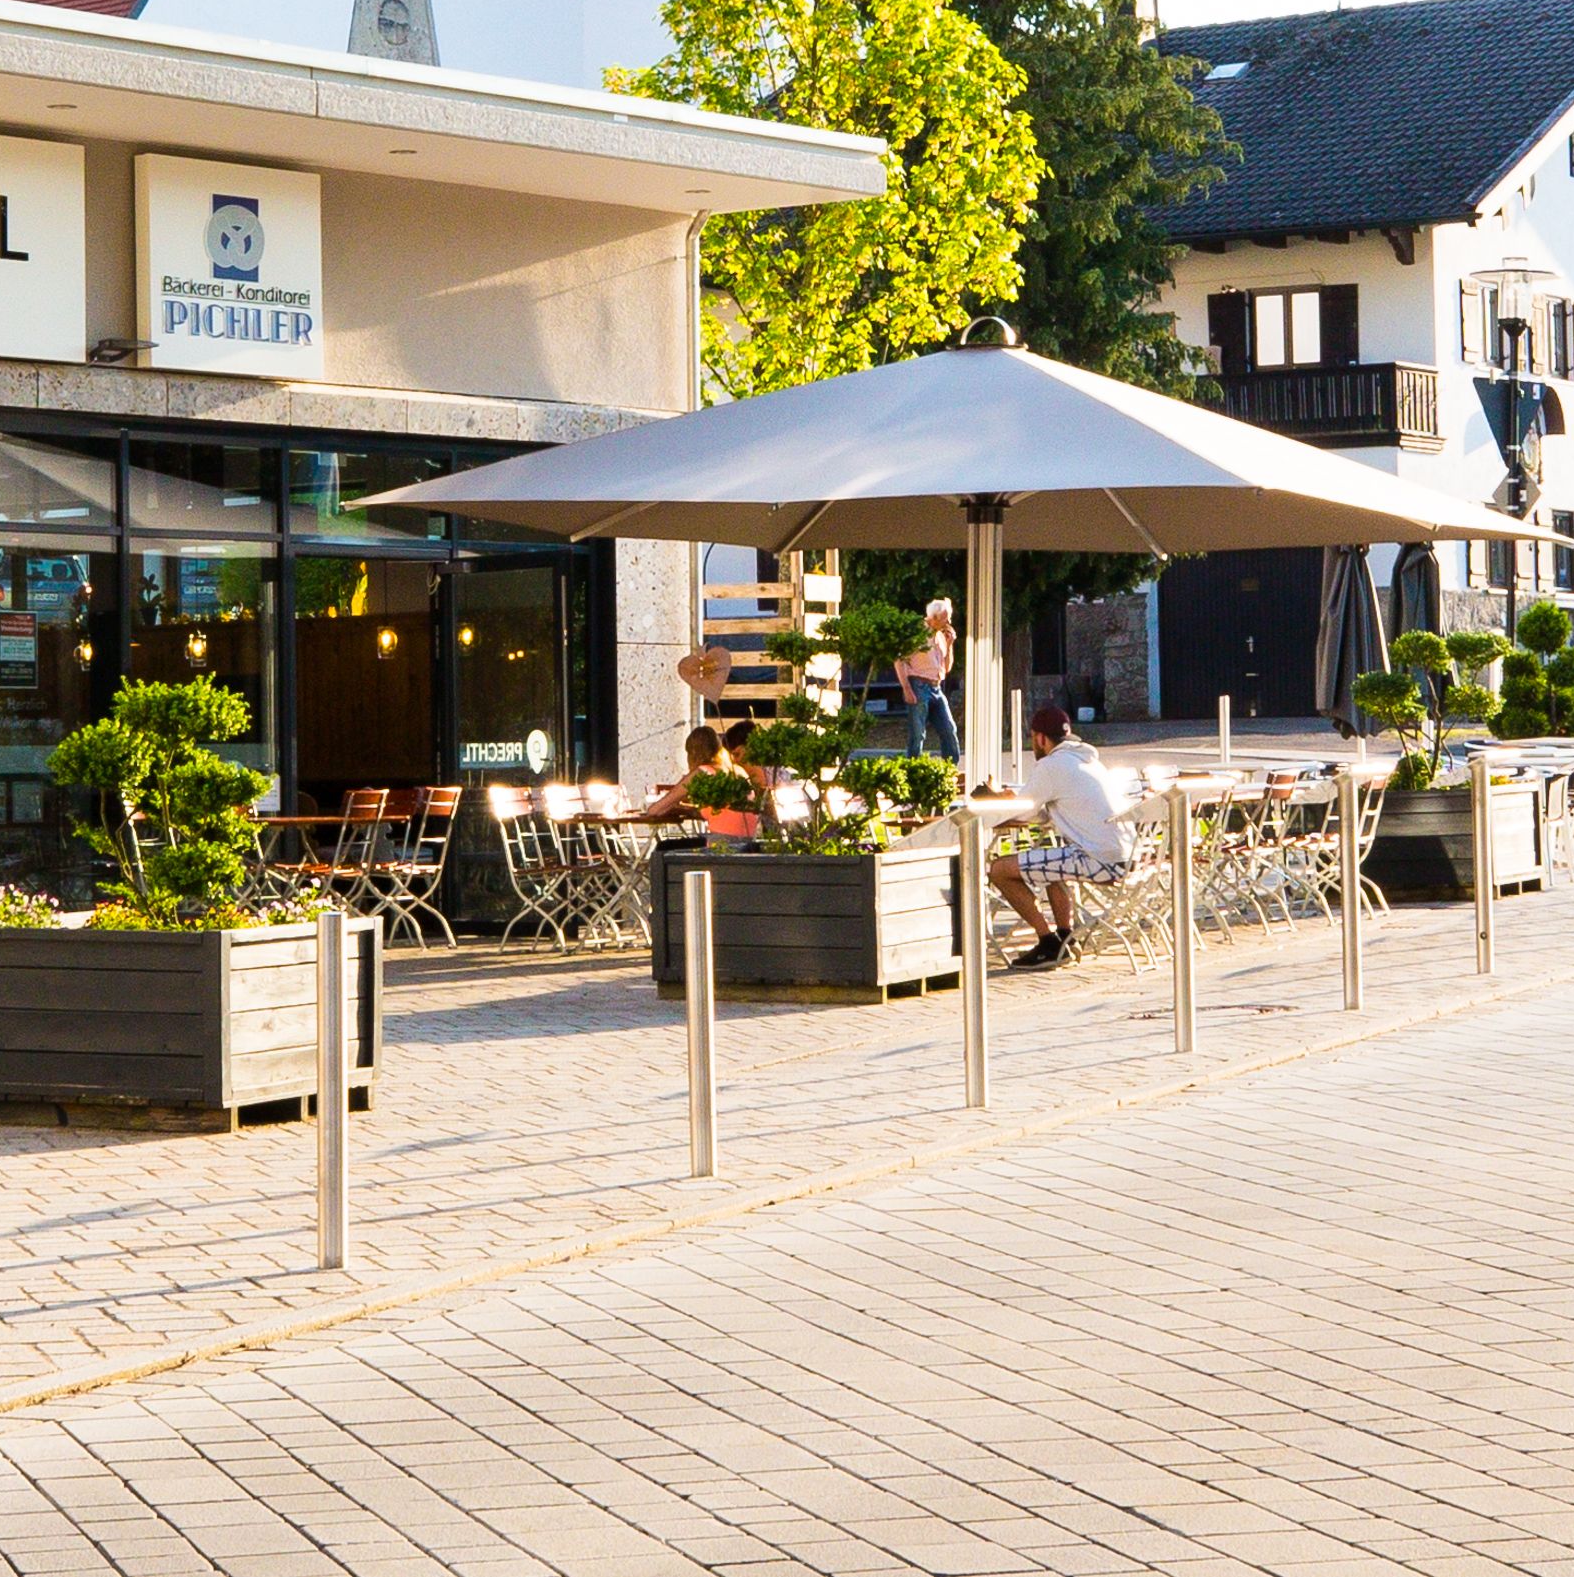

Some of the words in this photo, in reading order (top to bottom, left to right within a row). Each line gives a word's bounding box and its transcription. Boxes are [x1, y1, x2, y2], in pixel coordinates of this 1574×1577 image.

[162, 274, 224, 298] Bäckerei
[236, 283, 311, 306] Konditorei
[161, 299, 314, 347] PICHLER
